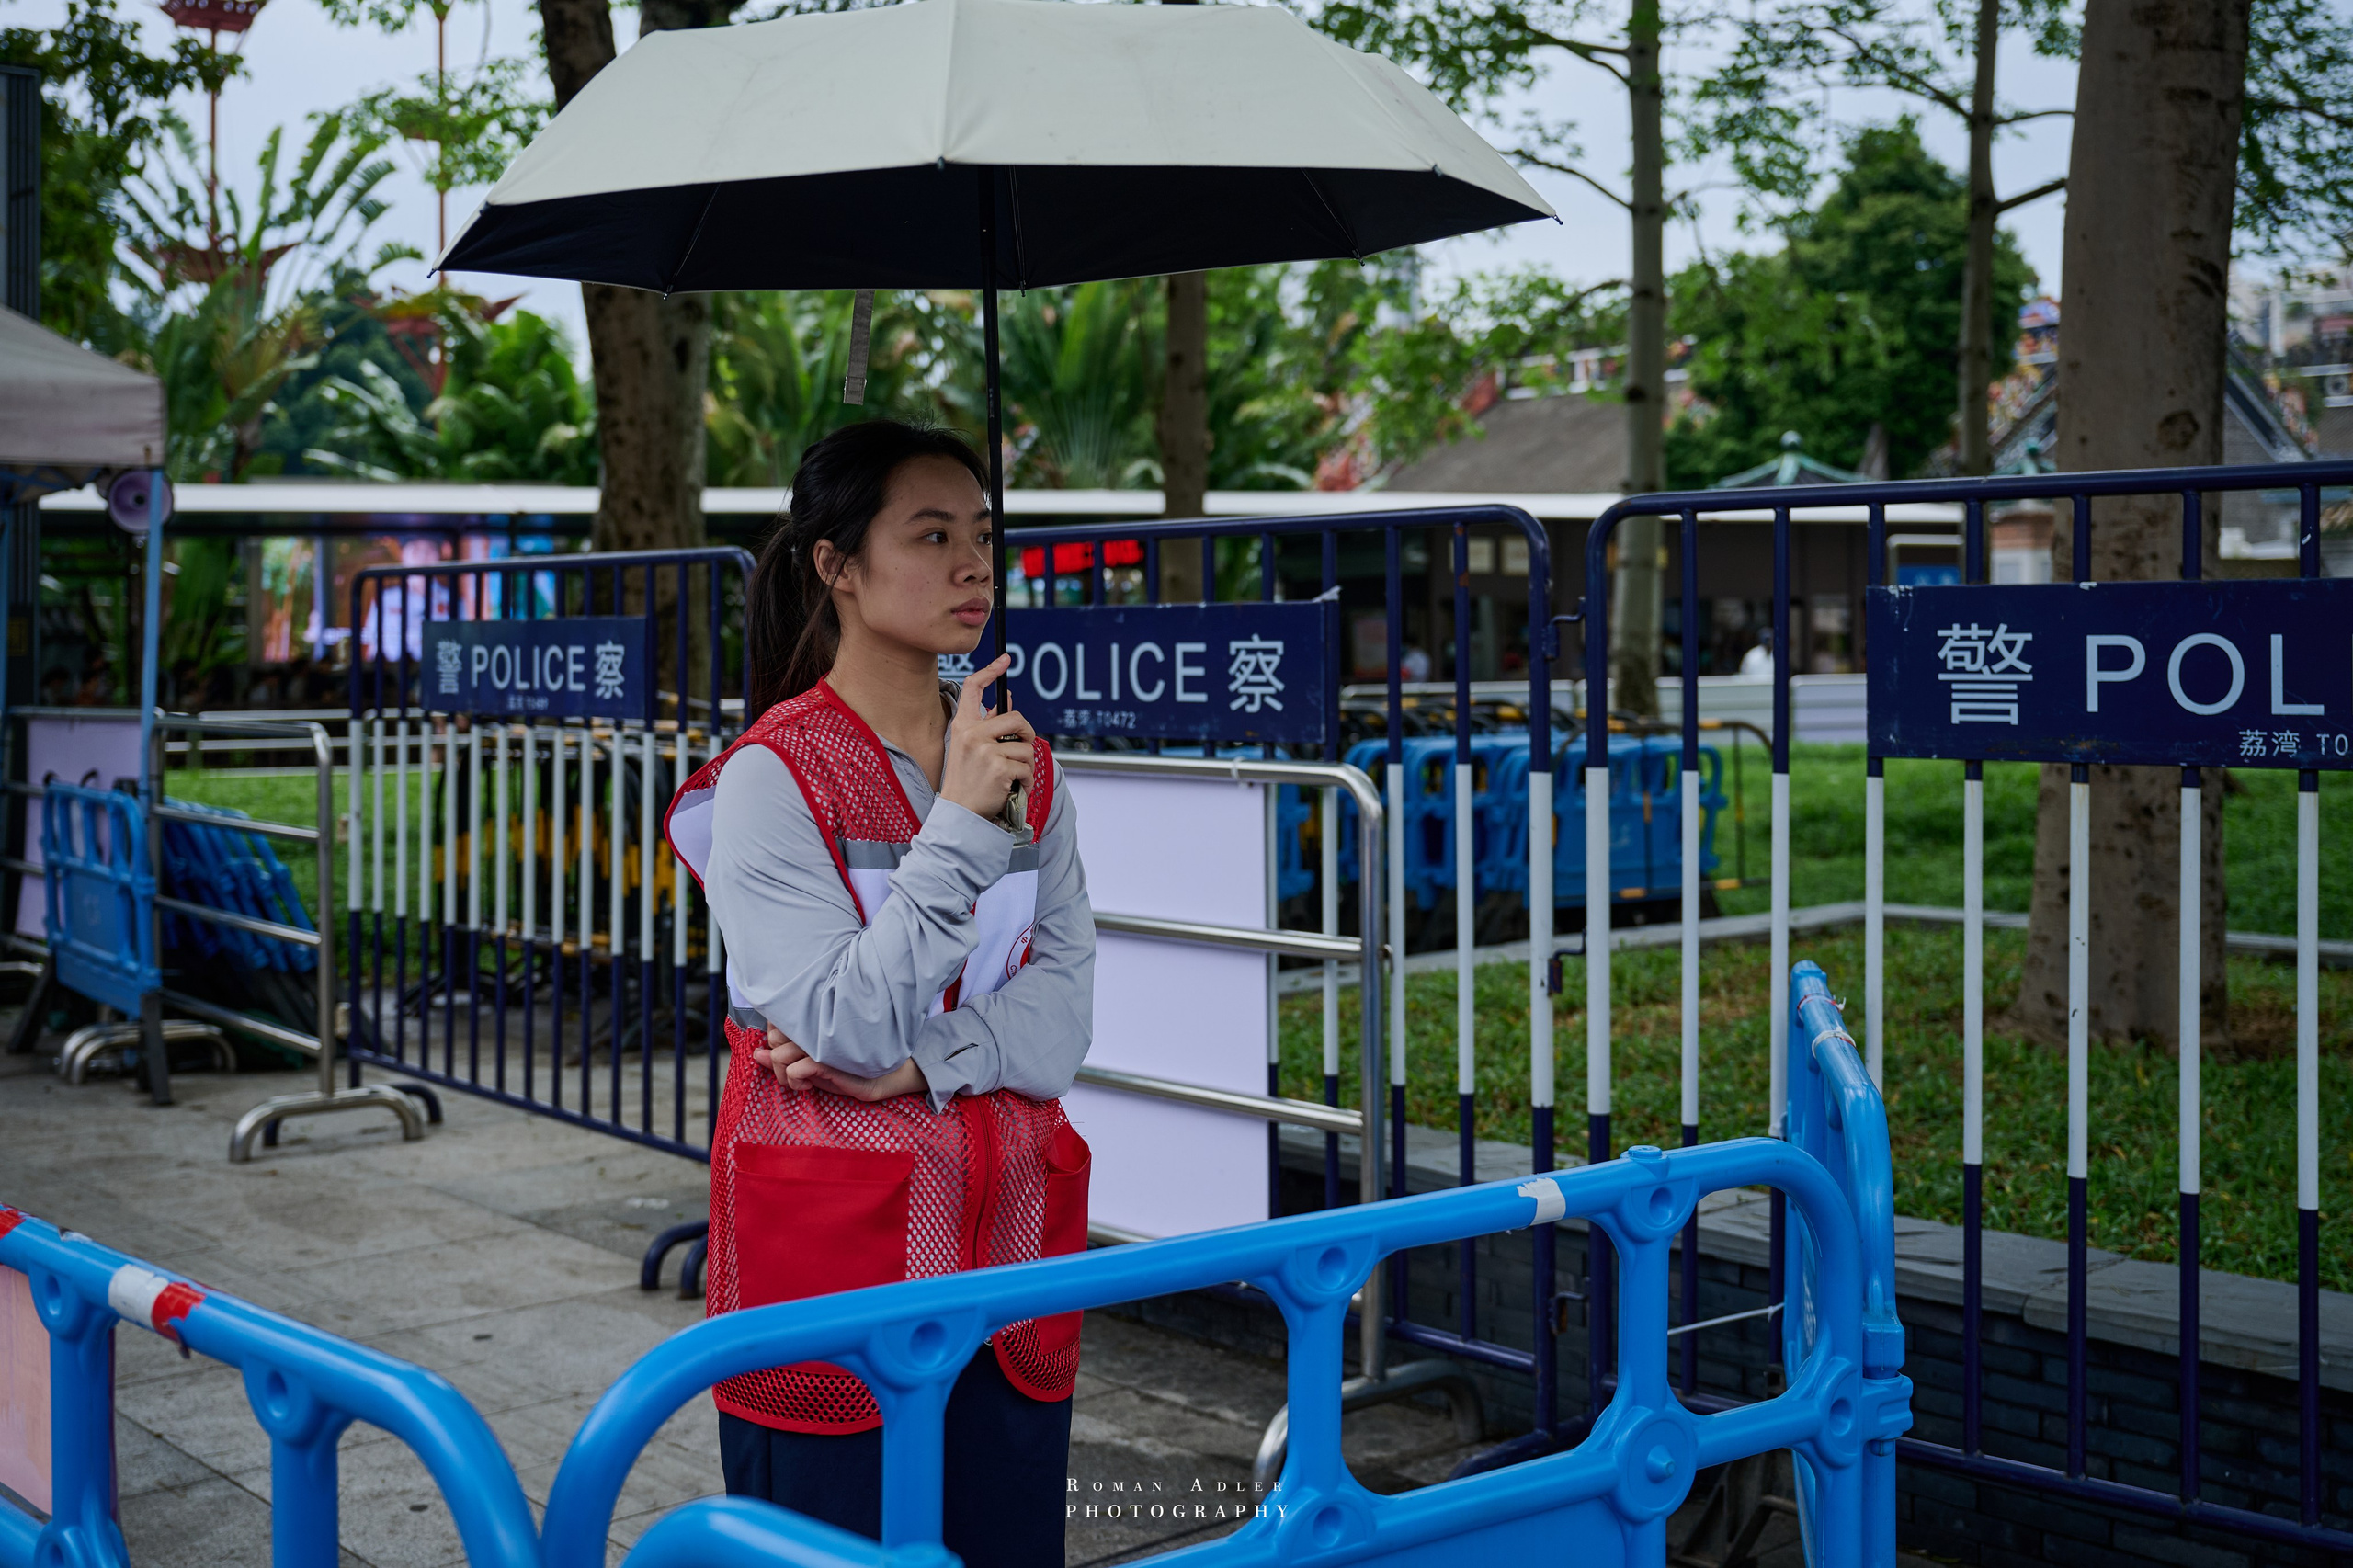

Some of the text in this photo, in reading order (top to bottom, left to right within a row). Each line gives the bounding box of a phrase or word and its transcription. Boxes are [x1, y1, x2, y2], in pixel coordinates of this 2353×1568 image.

[437, 639, 624, 699] 警 POLICE 察
[1006, 642, 1208, 701] POLICE
[1228, 633, 1285, 714] 察
[1938, 623, 2353, 725] 警 POL
[2238, 729, 2300, 758] 荔湾
